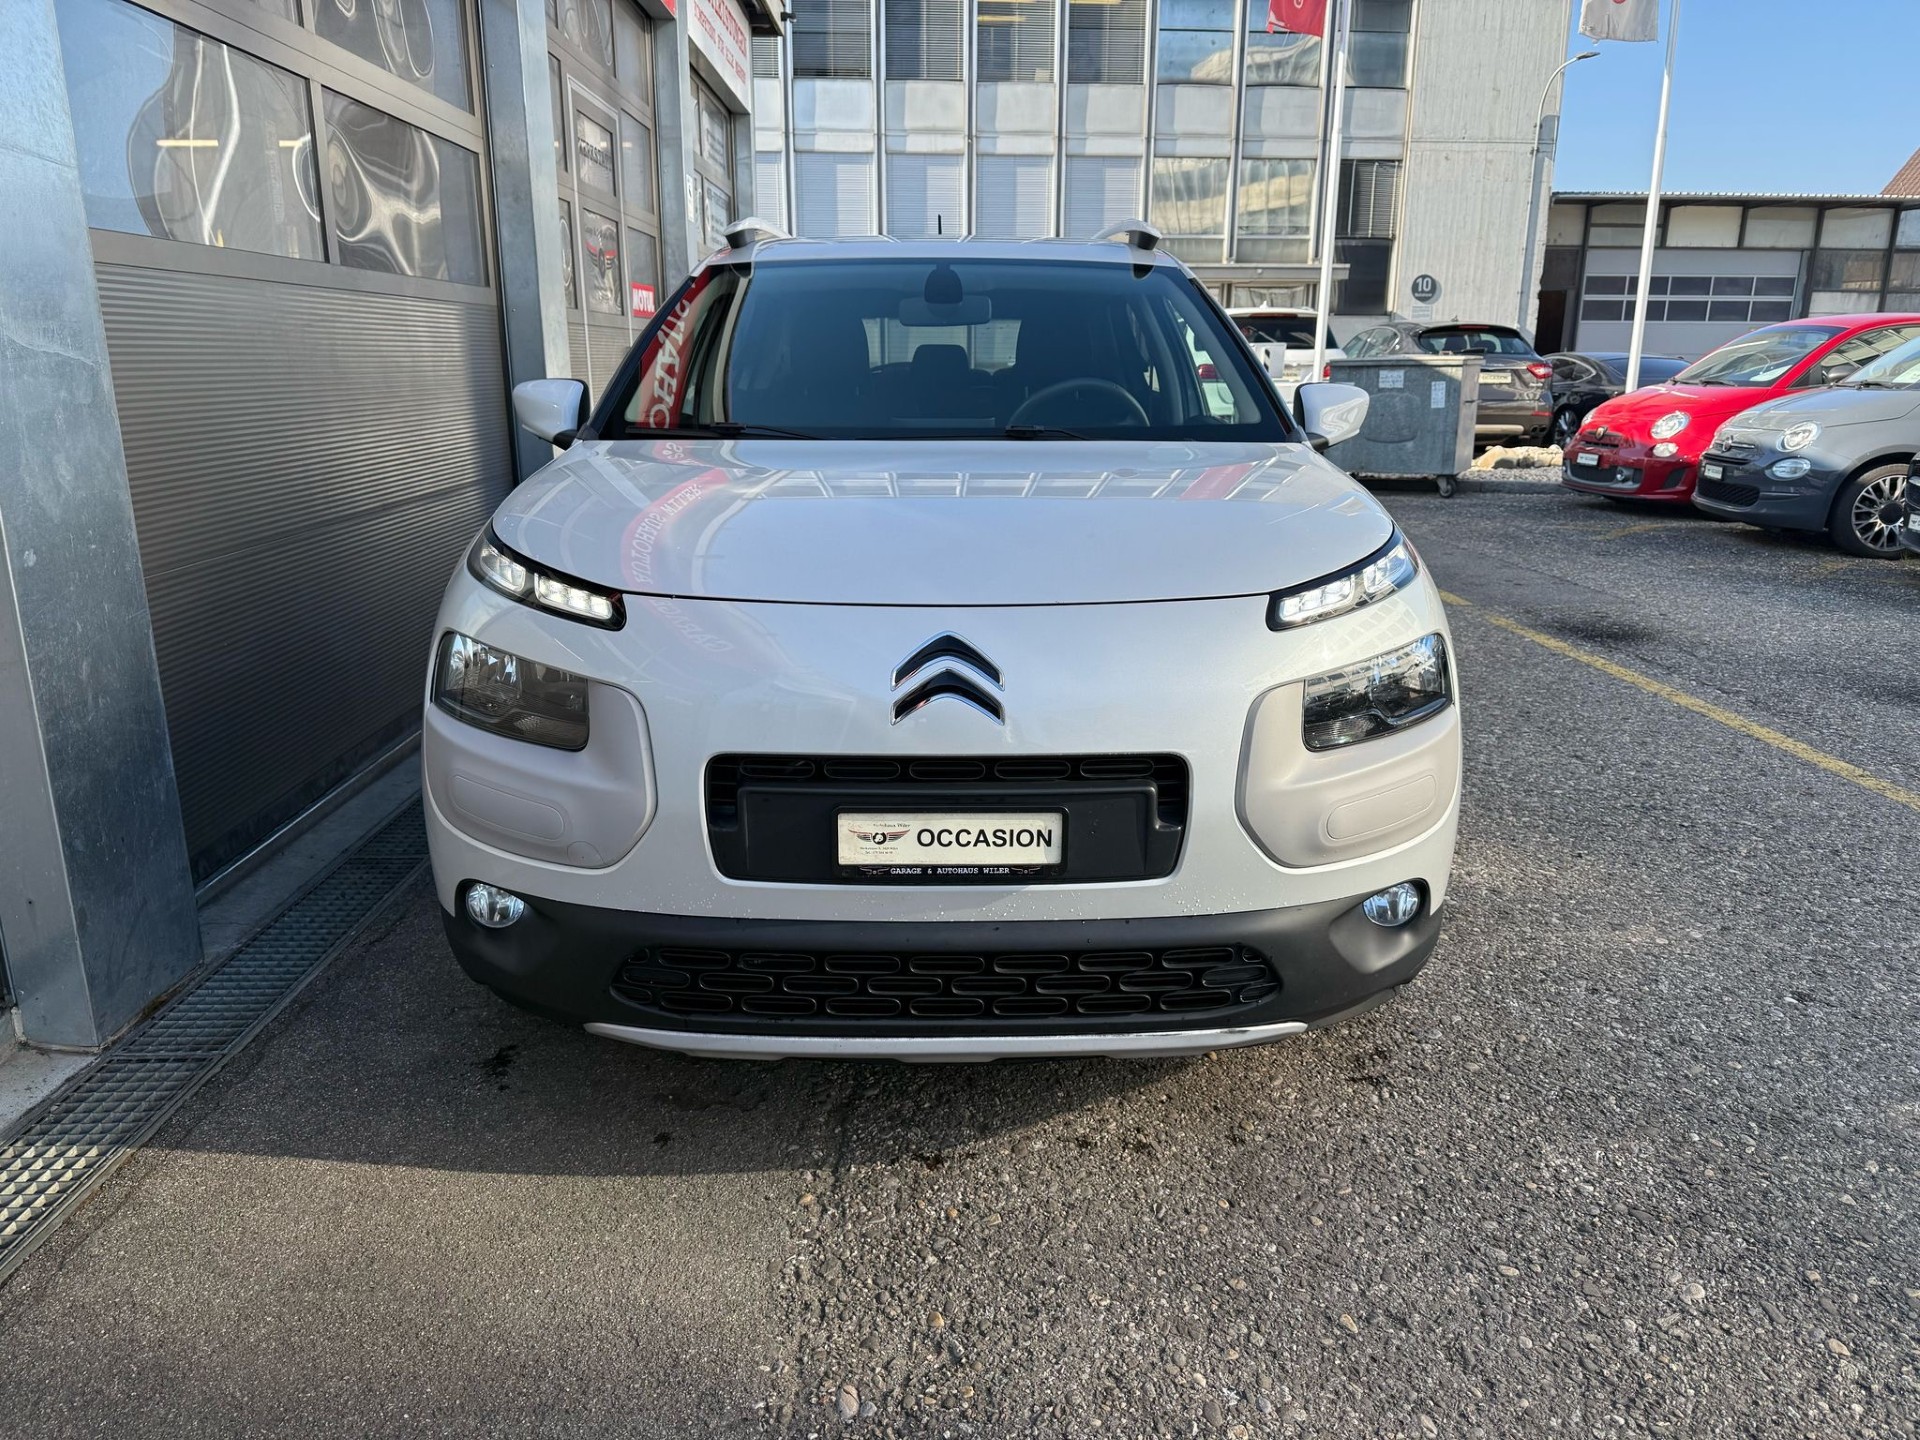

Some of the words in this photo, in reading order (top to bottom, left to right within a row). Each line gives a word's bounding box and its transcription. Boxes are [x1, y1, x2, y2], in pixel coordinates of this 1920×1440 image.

[1416, 277, 1432, 292] 10
[632, 288, 655, 312] MOTUL
[917, 828, 1053, 848] OCCASION
[890, 867, 922, 875] GARAGE
[927, 867, 932, 875] &
[937, 867, 979, 875] AUTOHAUS
[983, 867, 1010, 875] WILER
